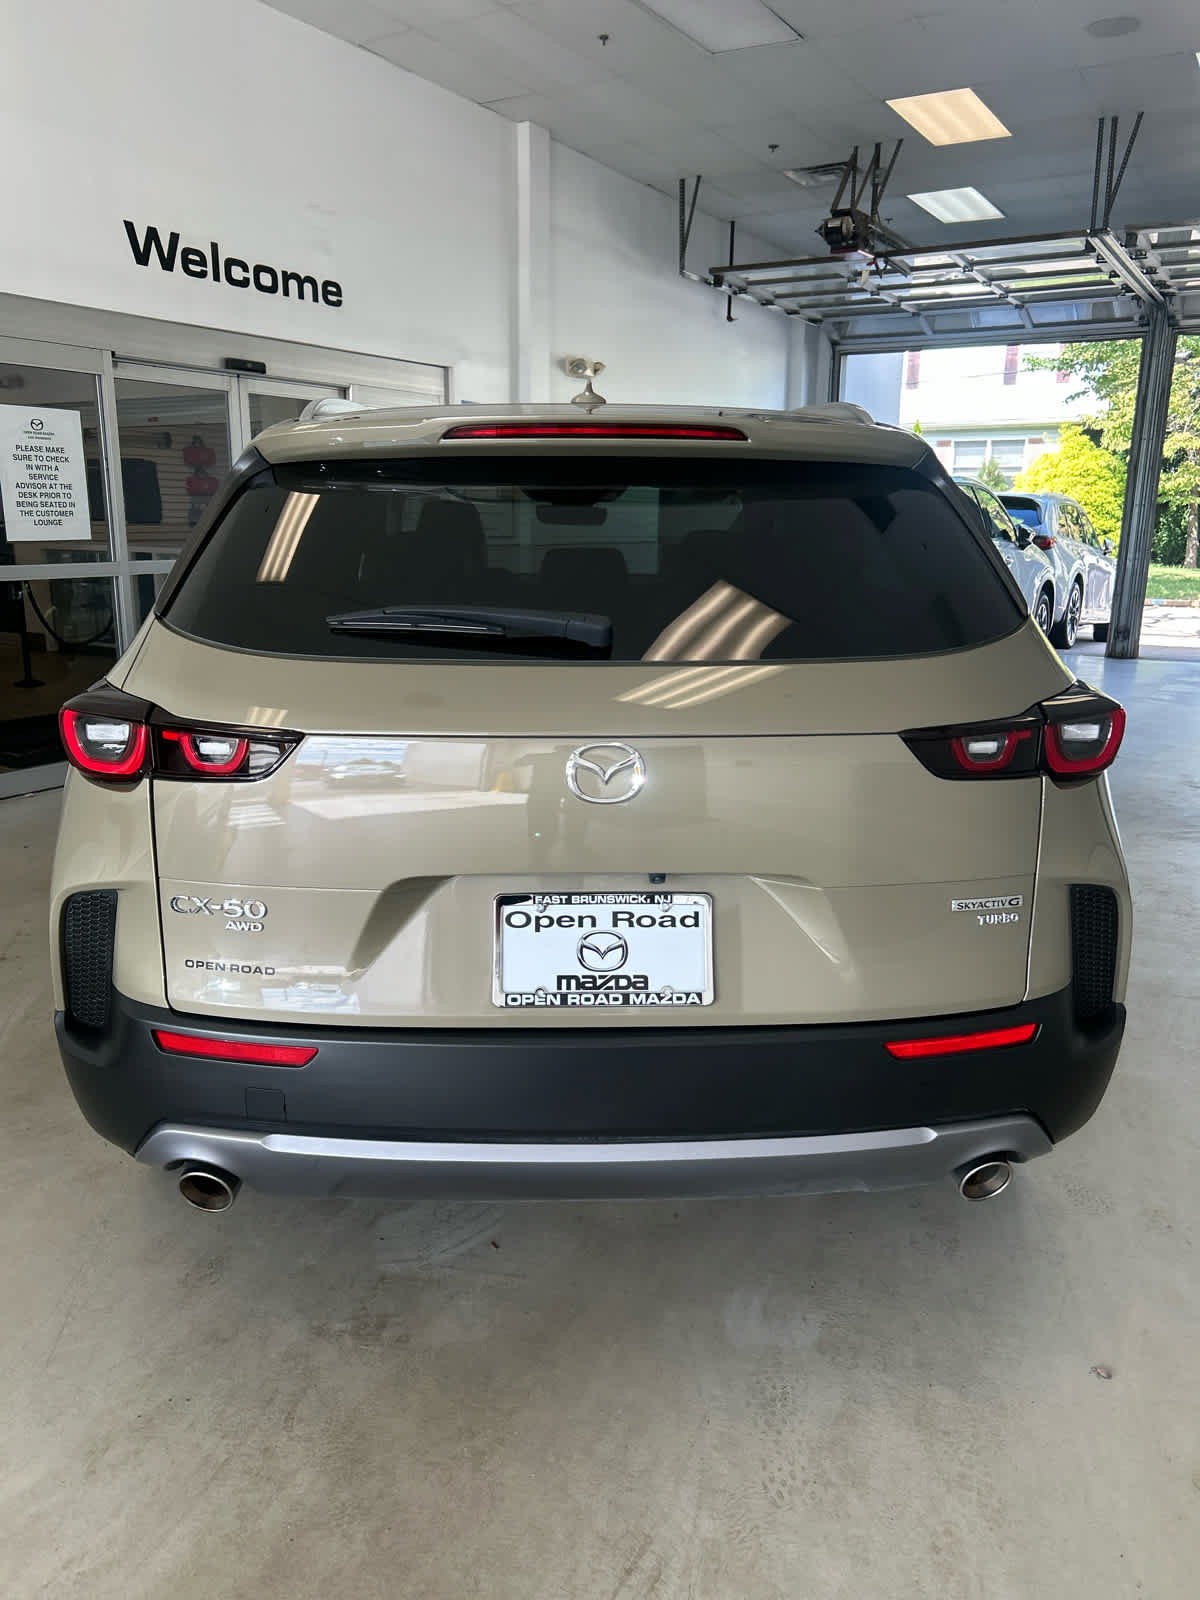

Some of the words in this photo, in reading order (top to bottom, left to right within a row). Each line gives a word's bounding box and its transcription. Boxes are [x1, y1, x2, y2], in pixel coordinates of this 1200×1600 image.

[123, 219, 343, 307] Welcome
[15, 444, 44, 453] PLEASE
[45, 446, 65, 454] MAKE
[12, 453, 33, 462] SURE
[45, 455, 70, 463] CHECK
[25, 463, 34, 471] IN
[28, 473, 59, 481] SERVICE
[15, 482, 47, 490] ADVISOR
[59, 483, 73, 491] THE
[18, 491, 38, 499] DESK
[39, 492, 61, 500] PRIOR
[61, 492, 72, 500] TO
[16, 500, 39, 508] BEING
[39, 501, 68, 509] SEATED
[68, 501, 76, 509] IN
[19, 510, 35, 518] THE
[35, 510, 74, 518] CUSTOMER
[33, 519, 64, 527] LOUNGE
[535, 895, 569, 905] EAST
[571, 894, 651, 905] BRUNSWICK,
[654, 894, 672, 905] NJ
[170, 895, 268, 919] CX-50
[504, 910, 598, 933] Open
[611, 910, 700, 929] Road
[976, 912, 1019, 926] TURBO
[224, 920, 265, 932] AWD
[184, 958, 226, 972] OPEN
[229, 962, 276, 976] ROAD
[506, 993, 561, 1006] OPEN
[566, 993, 624, 1006] ROAD
[629, 992, 701, 1006] MAZDA
